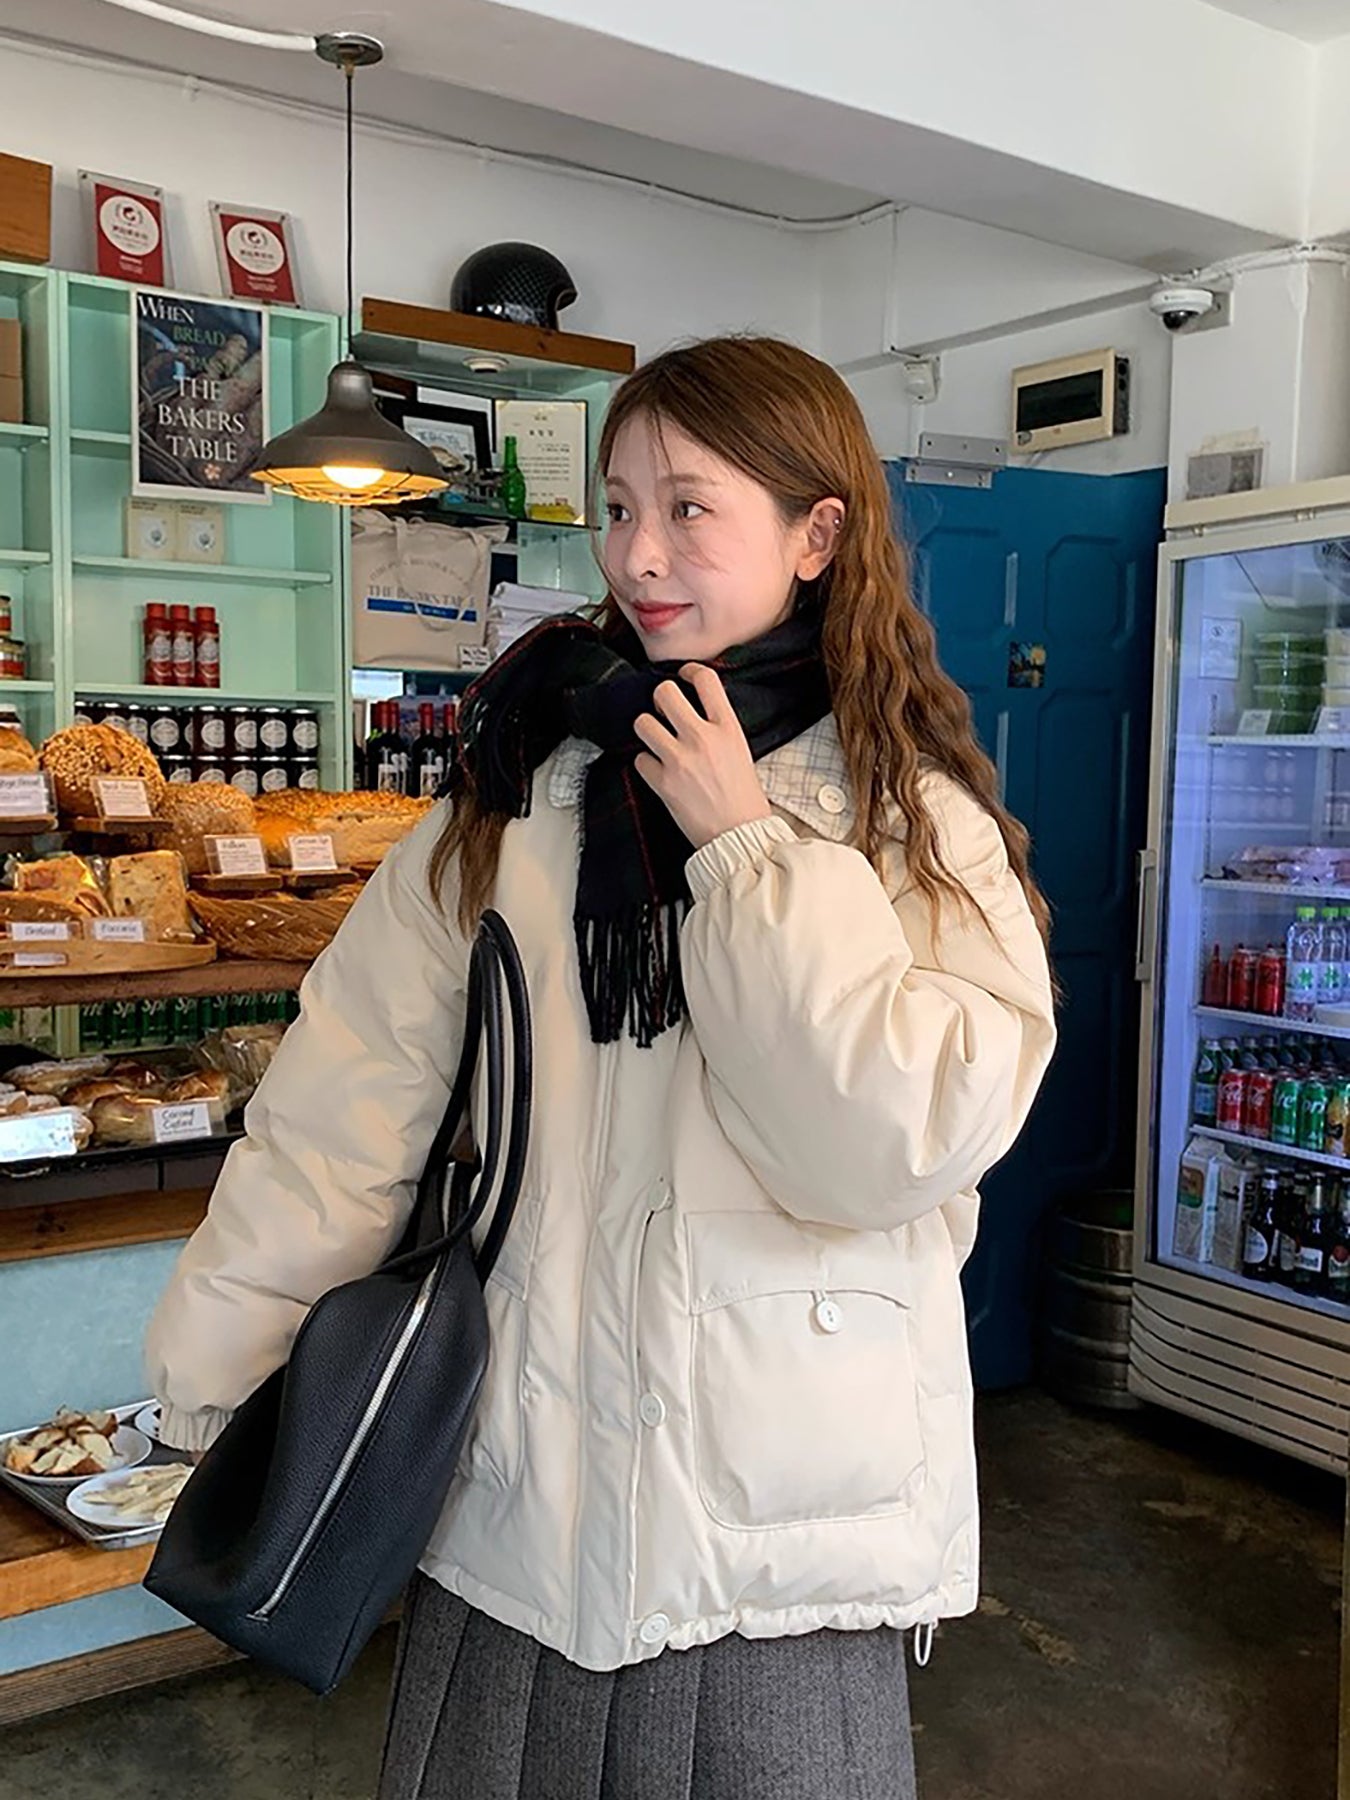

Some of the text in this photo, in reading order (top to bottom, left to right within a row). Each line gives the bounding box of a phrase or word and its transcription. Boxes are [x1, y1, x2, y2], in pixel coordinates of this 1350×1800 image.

[173, 325, 226, 346] BREAD
[173, 374, 222, 401] THE
[158, 404, 245, 434] BAKERS
[166, 434, 238, 462] TABLE
